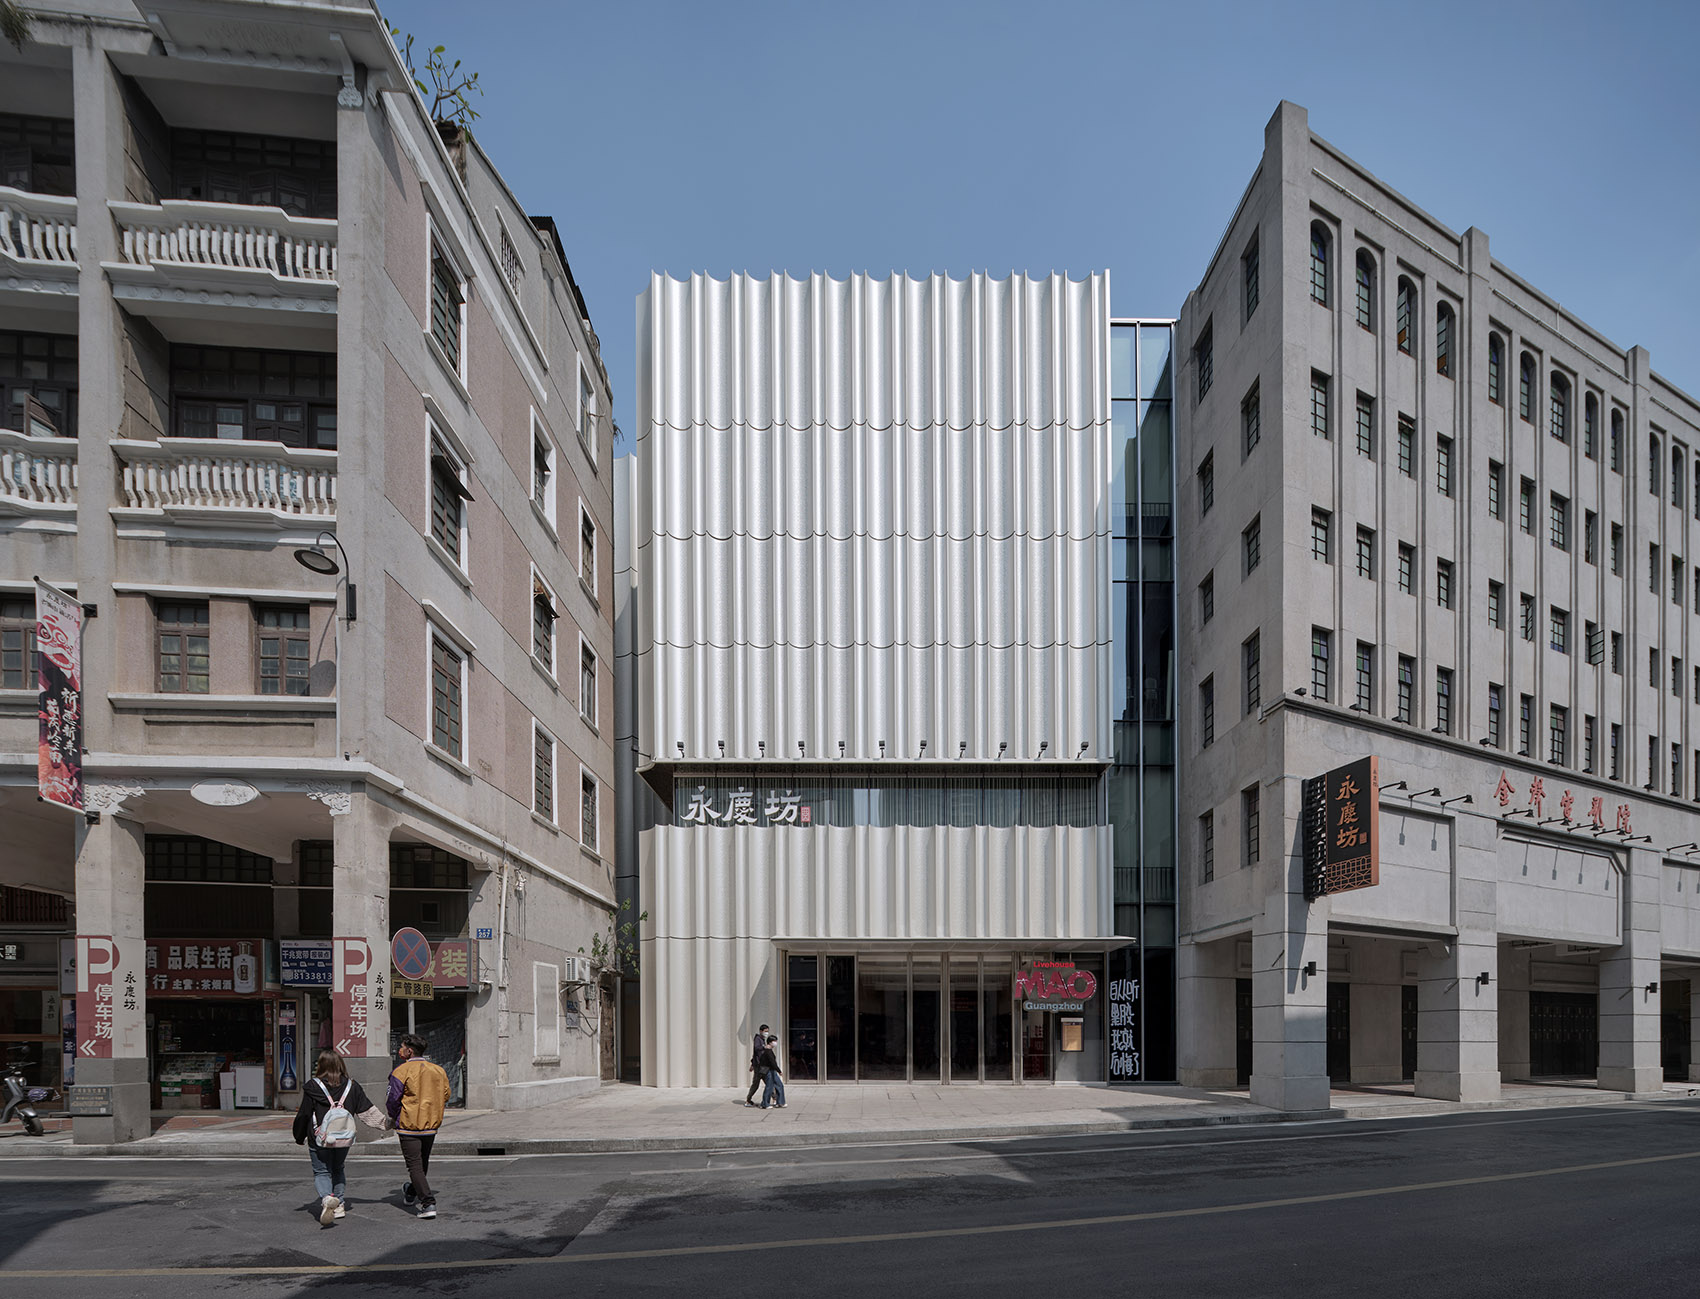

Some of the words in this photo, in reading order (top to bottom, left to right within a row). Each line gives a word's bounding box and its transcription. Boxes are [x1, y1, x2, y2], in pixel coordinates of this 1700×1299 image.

[680, 786, 802, 823] 永慶坊
[77, 938, 120, 993] P
[167, 945, 232, 970] 品质生活
[333, 940, 373, 993] P
[424, 948, 468, 978] 装
[393, 980, 432, 997] 严管路段
[1014, 970, 1097, 999] MAO
[94, 984, 114, 1040] 停车场
[349, 984, 368, 1039] 停车场
[1025, 1002, 1084, 1012] Guangzhou
